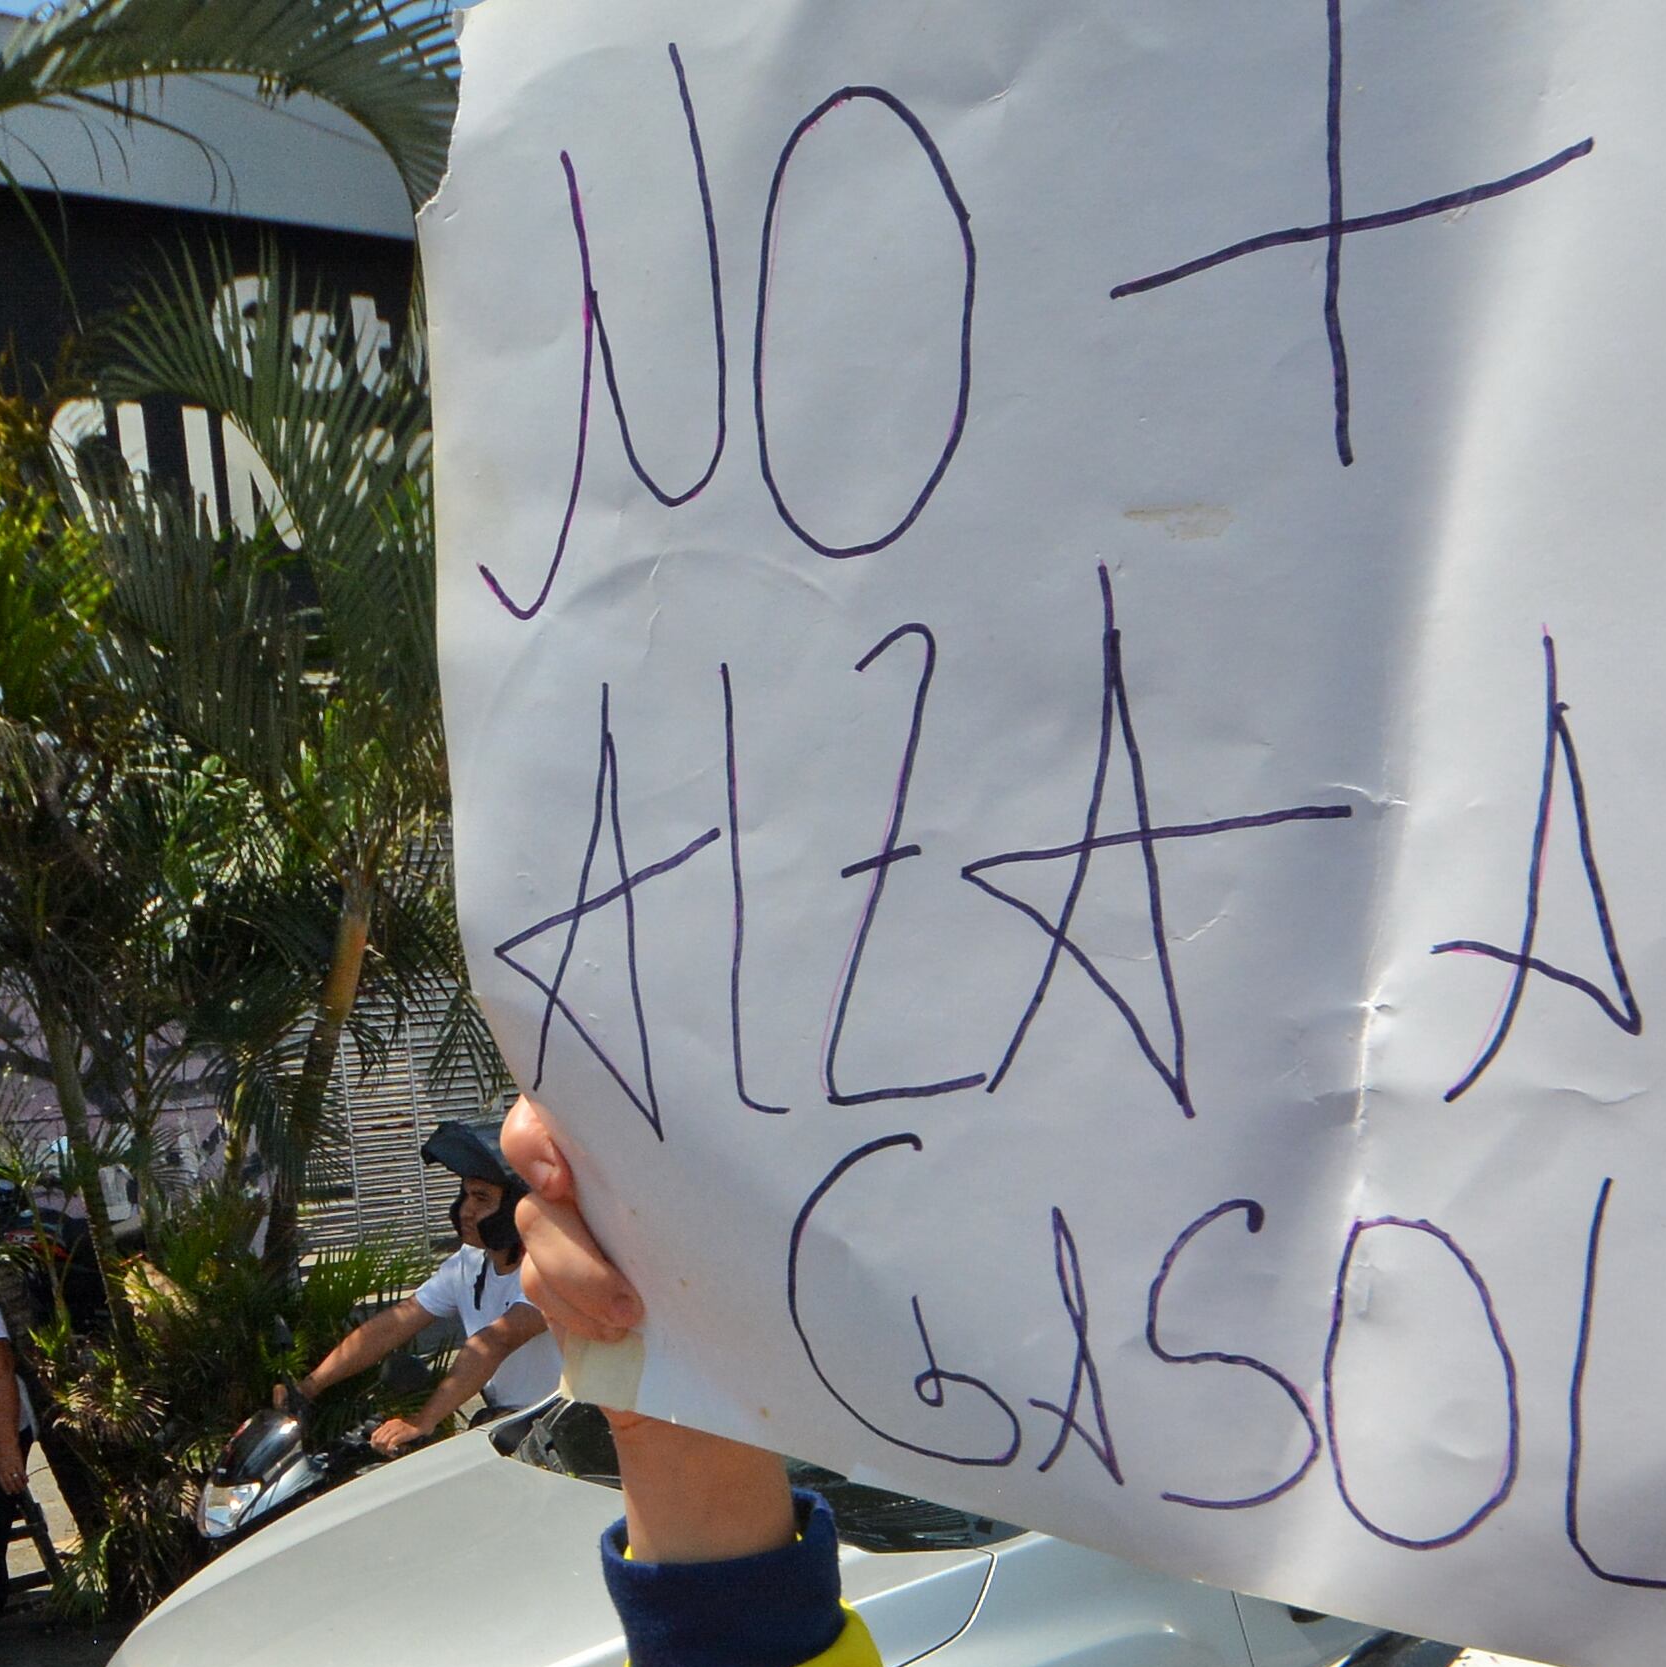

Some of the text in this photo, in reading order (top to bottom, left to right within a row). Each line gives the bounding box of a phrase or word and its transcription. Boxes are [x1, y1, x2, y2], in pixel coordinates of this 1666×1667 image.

[477, 40, 976, 620] NO
[494, 556, 1353, 1144] ALZA
[1430, 622, 1643, 1104] A
